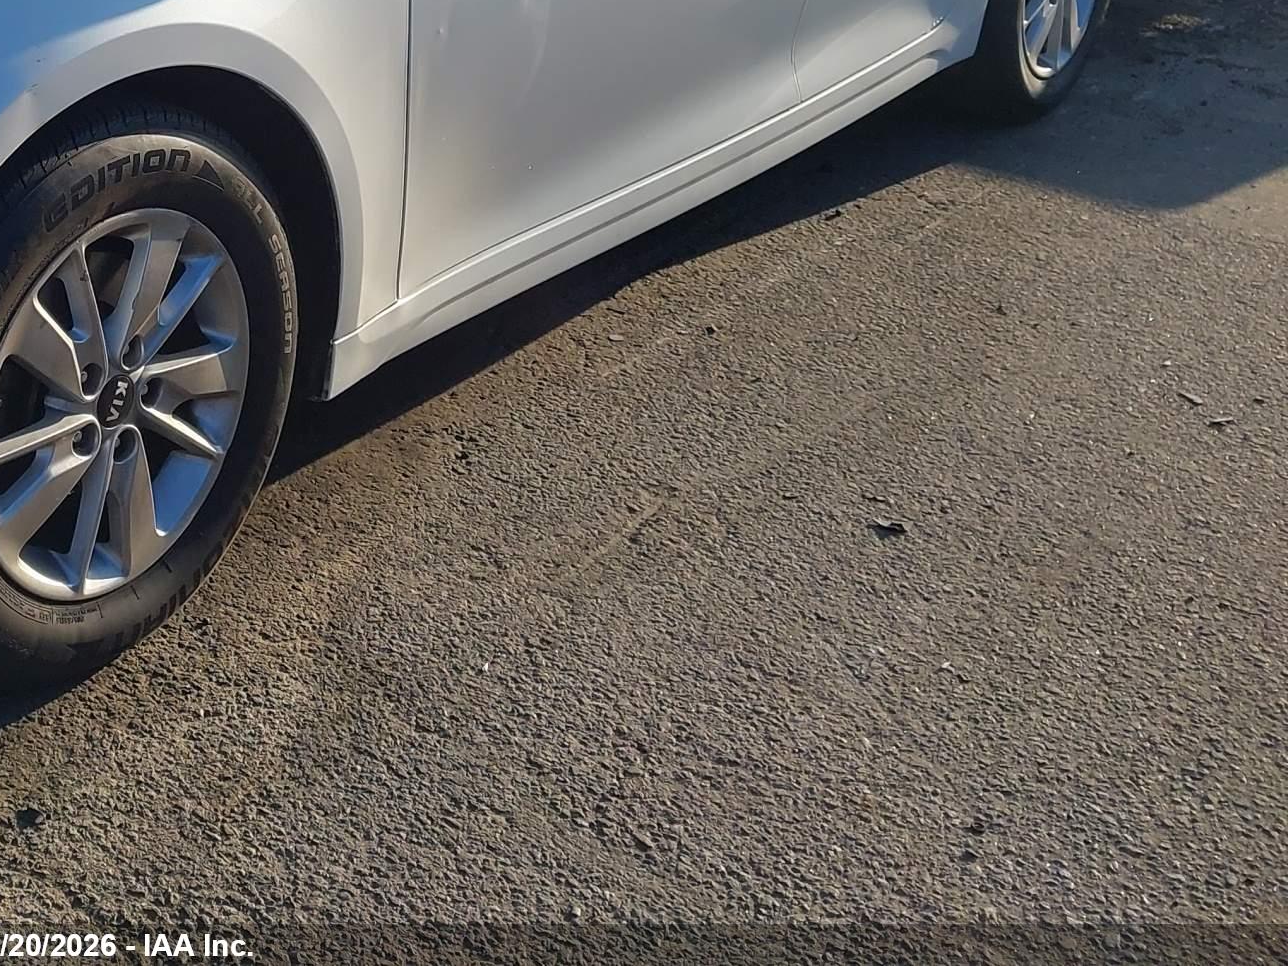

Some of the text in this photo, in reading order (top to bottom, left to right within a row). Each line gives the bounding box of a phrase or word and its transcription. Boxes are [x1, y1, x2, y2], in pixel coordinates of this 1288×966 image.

[41, 149, 192, 233] EDITION
[231, 176, 293, 355] ALL SEASON
[105, 380, 129, 422] KIA
